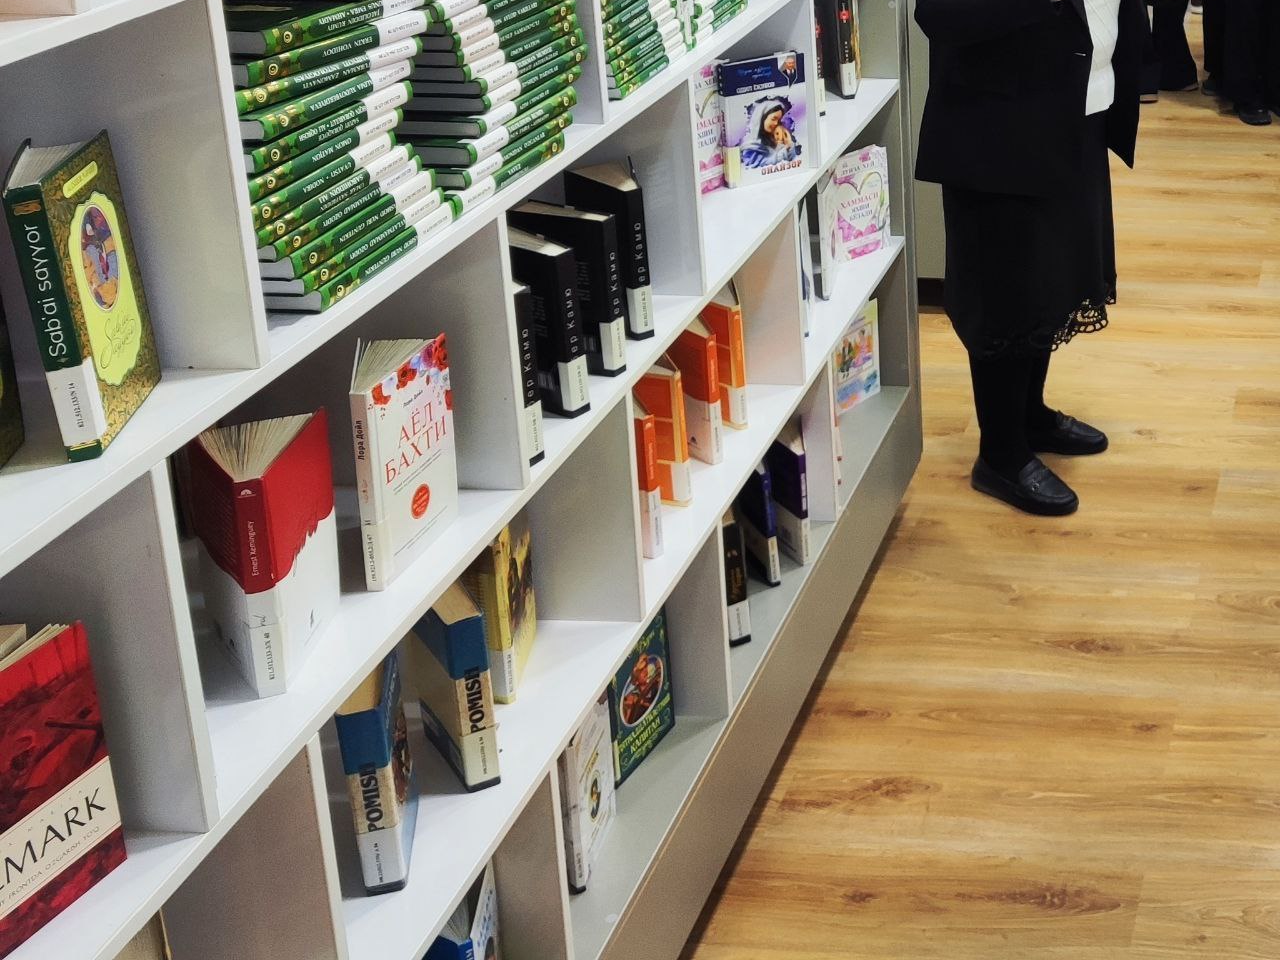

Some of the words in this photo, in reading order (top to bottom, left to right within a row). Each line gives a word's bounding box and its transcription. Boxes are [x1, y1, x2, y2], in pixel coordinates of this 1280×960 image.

[322, 44, 352, 59] VOHIDOV
[354, 36, 373, 47] ERKIN
[312, 144, 335, 162] MATJON
[335, 137, 352, 150] OMON
[24, 224, 52, 291] sayyor
[633, 221, 644, 261] Камю
[609, 251, 619, 292] Камю
[565, 287, 576, 330] Камю
[521, 327, 533, 373] Камю
[356, 419, 365, 440] Дойл
[398, 401, 434, 449] АЁЛ
[357, 440, 366, 461] Лора
[385, 415, 448, 485] БАХТИ
[251, 553, 259, 577] Ernest
[0, 787, 107, 890] MARK
